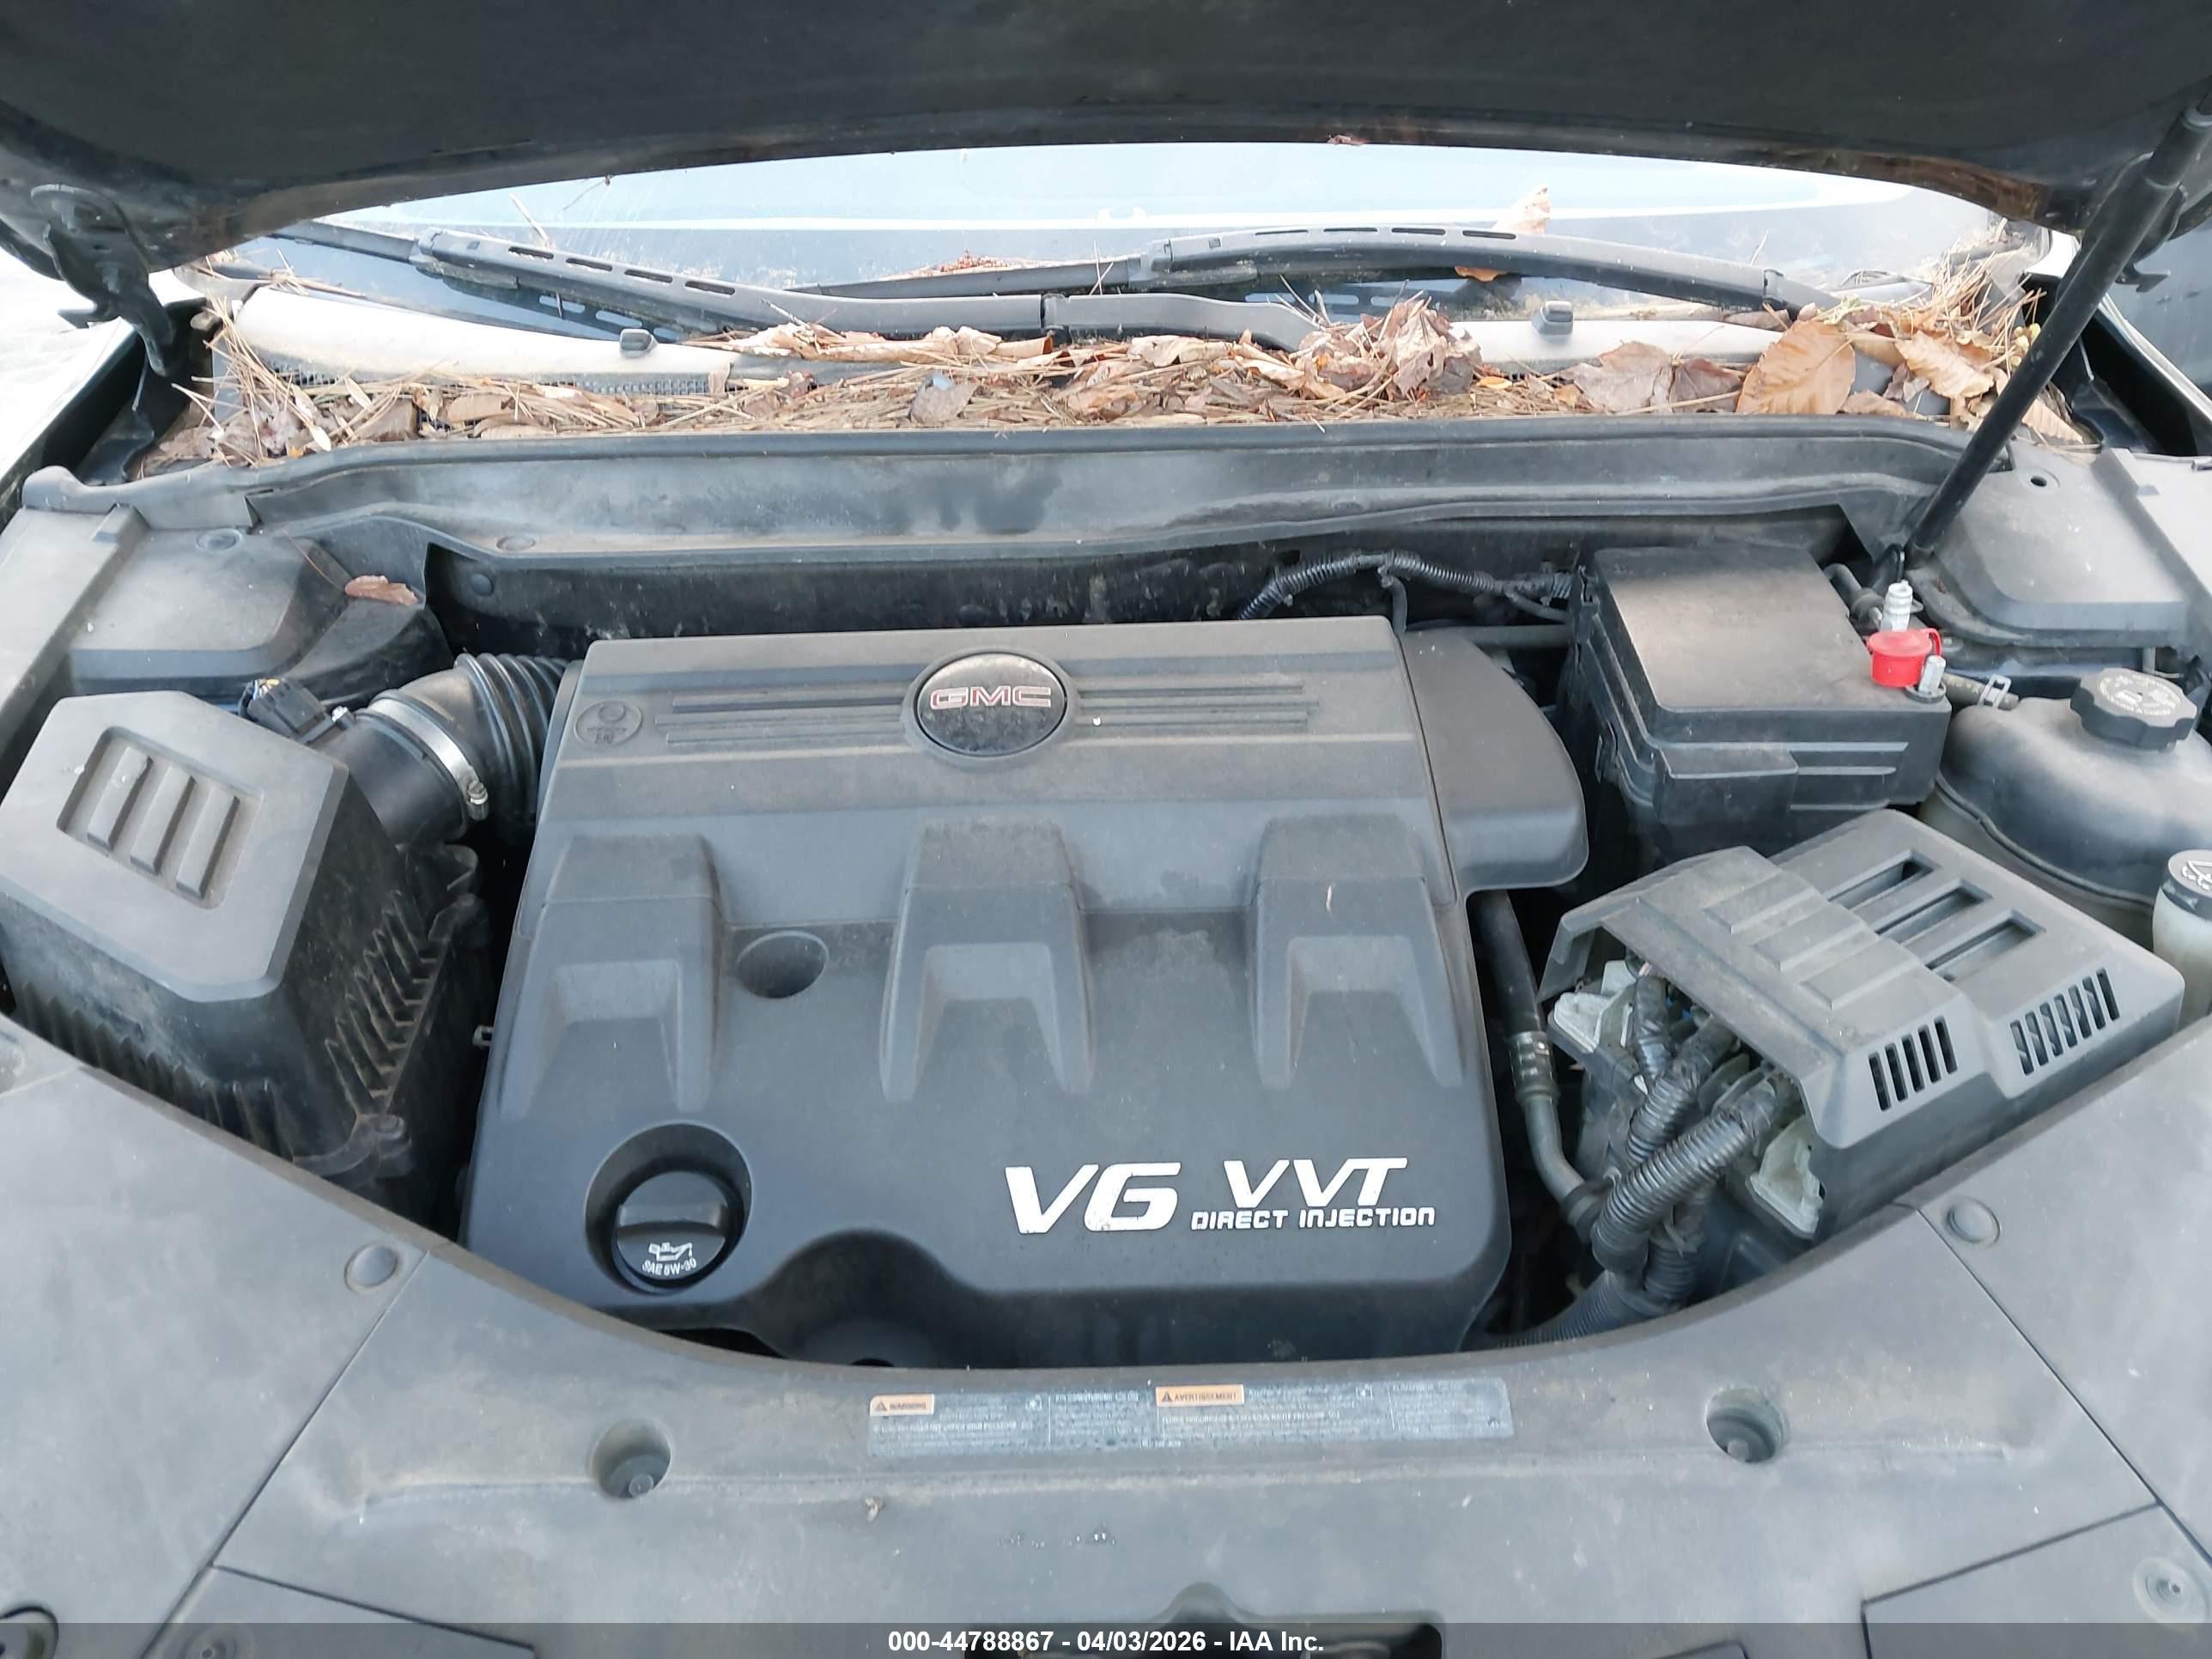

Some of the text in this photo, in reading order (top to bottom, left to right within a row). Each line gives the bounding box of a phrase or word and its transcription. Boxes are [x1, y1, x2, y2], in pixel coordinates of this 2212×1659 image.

[930, 685, 1052, 710] GMC
[1005, 1158, 1408, 1235] V6 VVT
[1190, 1207, 1437, 1231] DIRECT INJECTION
[642, 1260, 663, 1276] SAE
